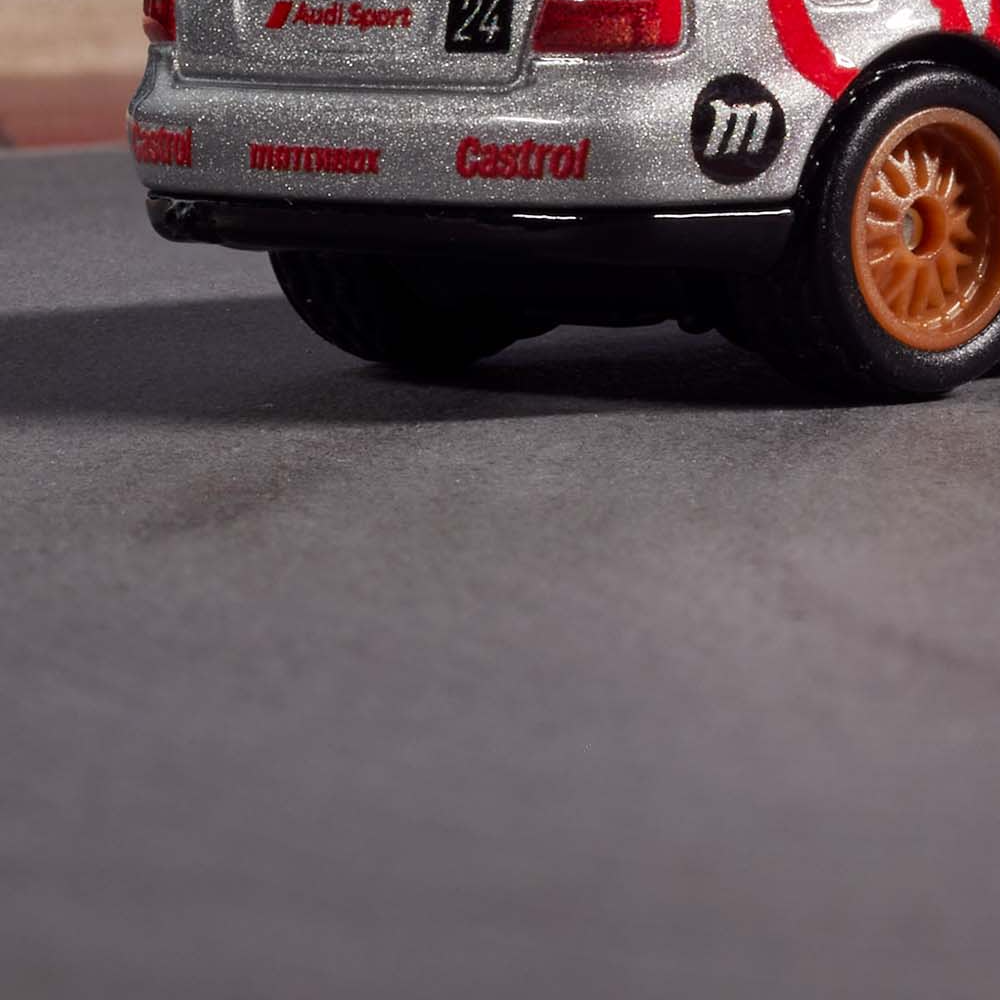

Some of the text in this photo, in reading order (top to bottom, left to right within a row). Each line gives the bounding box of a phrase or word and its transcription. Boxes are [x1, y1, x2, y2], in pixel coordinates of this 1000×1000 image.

[293, 2, 413, 32] Audi Sport
[456, 136, 590, 180] Castrol
